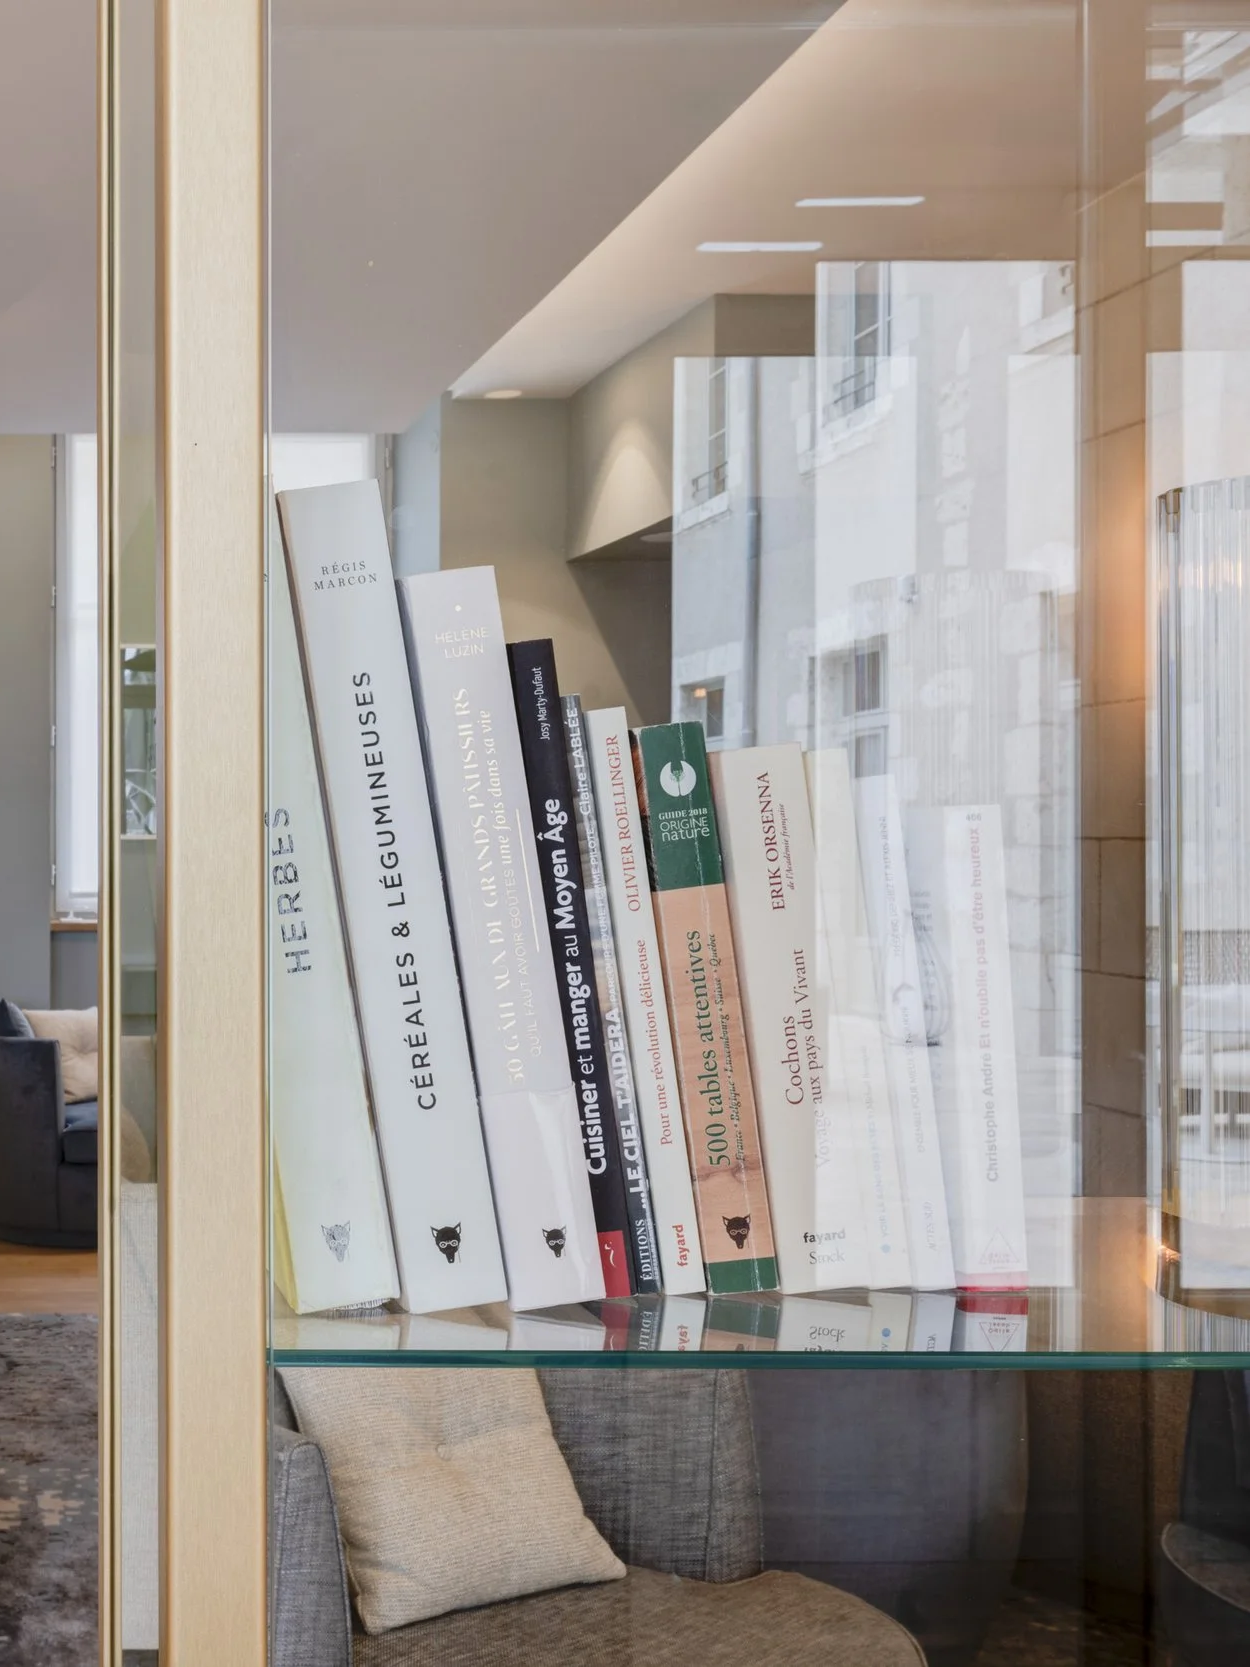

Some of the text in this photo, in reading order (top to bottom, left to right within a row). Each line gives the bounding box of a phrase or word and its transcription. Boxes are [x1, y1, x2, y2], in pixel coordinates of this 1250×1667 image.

[314, 573, 378, 590] MARCON
[321, 561, 366, 575] RÉGIS
[444, 644, 484, 658] LUZIN
[476, 709, 493, 734] vie
[531, 666, 551, 741] Josy Marty-Dufaut
[483, 737, 497, 755] sa
[563, 706, 592, 817] Claire LABLÉE
[486, 758, 503, 798] dans
[489, 801, 512, 831] fois
[605, 734, 641, 912] OLIVIER ROELLINGER
[658, 807, 708, 820] GUIDE 2018
[660, 816, 709, 831] ORIGINE
[661, 826, 710, 842] nature
[778, 802, 791, 839] française
[471, 814, 498, 908] GRANDS
[497, 834, 513, 865] une
[756, 771, 786, 910] ERIK ORSENNA
[264, 807, 312, 974] HERBES
[352, 672, 437, 1110] CÉRÉALES & LÉGUMINEUSES
[785, 880, 796, 891] de
[512, 931, 529, 975] AVOIR
[519, 980, 535, 1016] FAUT
[537, 798, 607, 1175] Cuisiner et manger au Moyen Âge
[968, 827, 999, 1183] Christophe André Et n'oublie pas d'être heureux
[607, 1007, 632, 1109] T'AIDERA
[636, 939, 673, 1146] Pour une révolution délicieuse
[685, 930, 731, 1166] 500 tables attentives
[706, 933, 747, 1163] France Belgique Luxembourg Suisse Québec
[780, 1015, 805, 1106] Cochons
[792, 948, 834, 1168] Voyage aux pays du Vivant
[506, 1057, 526, 1085] 50
[621, 1112, 640, 1162] CIEL
[634, 1218, 654, 1281] ÉDITIONS
[671, 1223, 691, 1267] fayard
[803, 1228, 846, 1245] fayard
